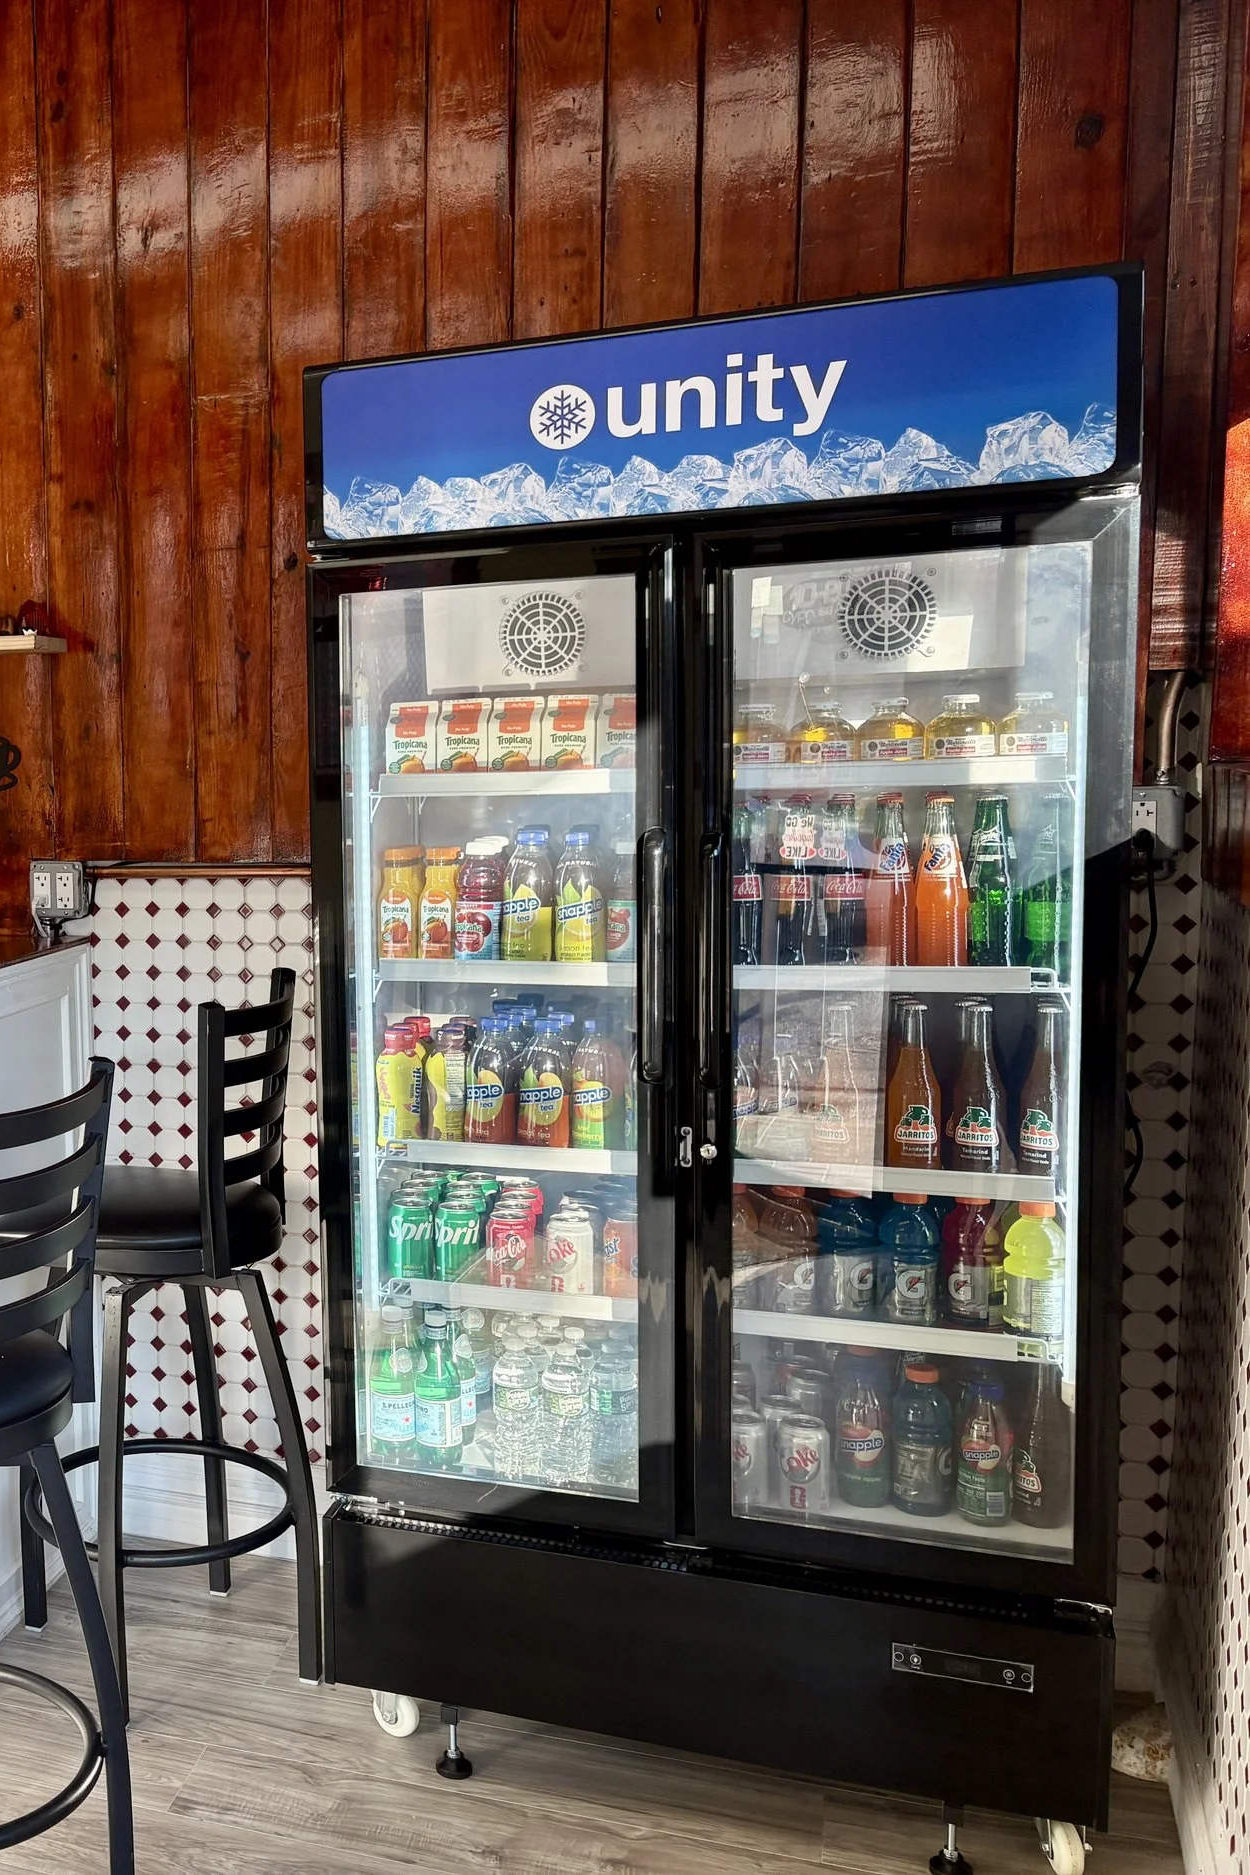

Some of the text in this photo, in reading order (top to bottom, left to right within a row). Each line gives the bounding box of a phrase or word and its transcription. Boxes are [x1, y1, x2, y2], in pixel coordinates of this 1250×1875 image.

[607, 353, 847, 436] unity
[444, 735, 480, 746] Tropicana
[496, 734, 532, 746] Tropicana
[550, 732, 587, 743] Tropicana
[392, 739, 428, 750] Tropicana
[879, 843, 904, 872] Fanta
[924, 843, 951, 872] Fanta
[772, 879, 807, 894] Coca-Cola
[382, 905, 409, 914] Tropicana
[423, 905, 449, 914] Tropicana
[503, 897, 540, 914] apple
[557, 898, 603, 921] snapple
[516, 914, 530, 923] tea
[585, 916, 598, 925] tea
[410, 1066, 422, 1114] Nesquik
[479, 1101, 493, 1109] tea
[540, 1104, 554, 1112] tea
[897, 1130, 934, 1139] JARRITOS
[957, 1132, 994, 1142] JARRITOS
[962, 1147, 989, 1155] Tamarind
[1023, 1150, 1047, 1159] Tamarind
[389, 1215, 434, 1245] Spri
[841, 1437, 882, 1453] snapple
[965, 1450, 999, 1460] snapple
